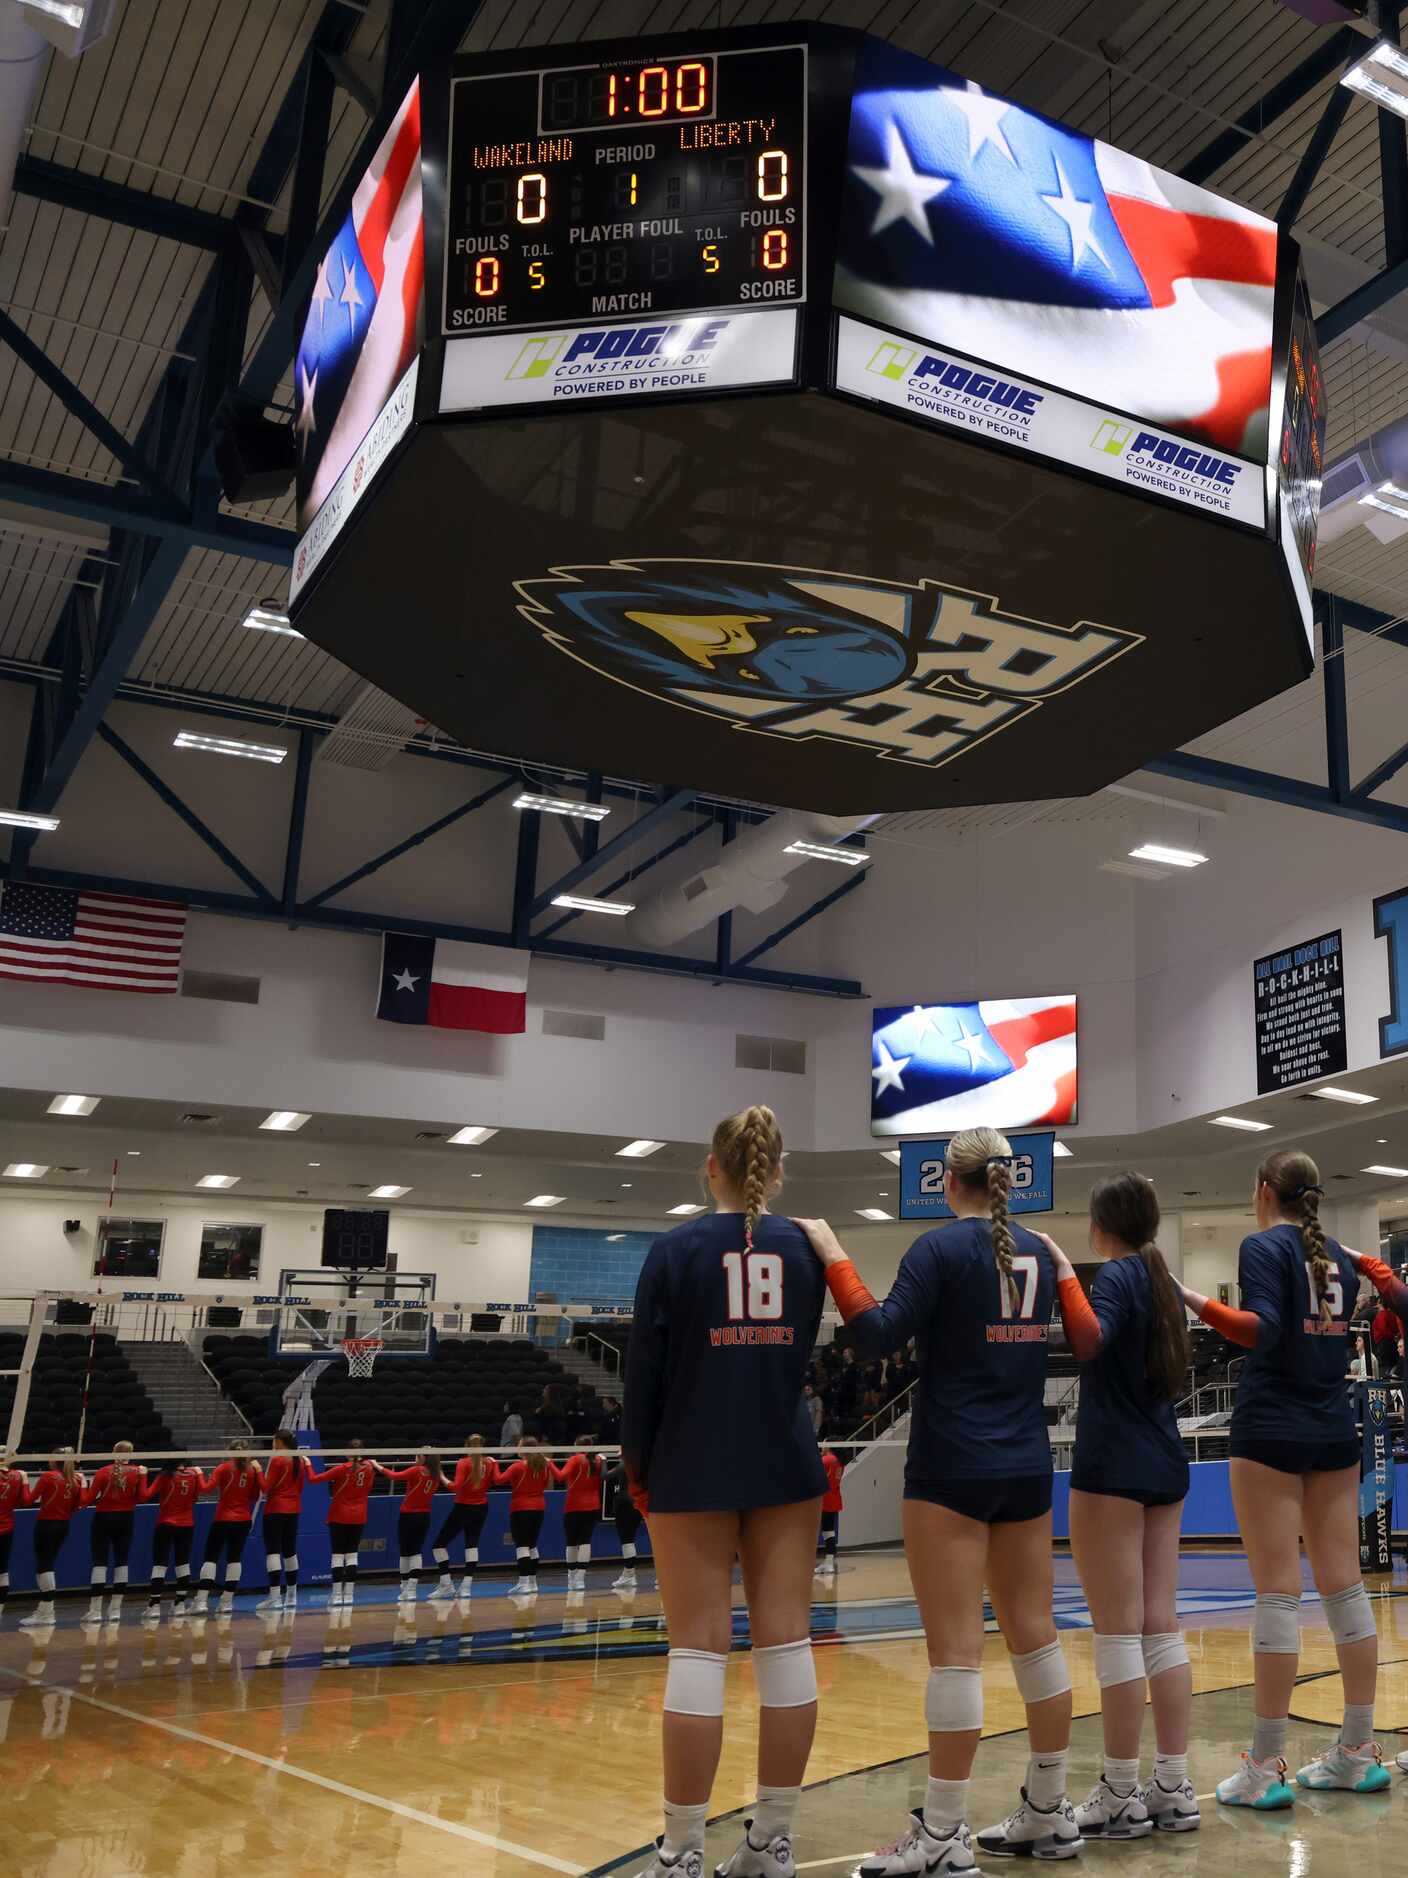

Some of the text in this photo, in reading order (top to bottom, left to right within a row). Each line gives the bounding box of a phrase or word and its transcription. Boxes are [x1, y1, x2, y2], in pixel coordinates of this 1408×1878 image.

[608, 62, 706, 117] 1:00
[679, 118, 776, 150] LIBERTY
[473, 138, 573, 169] WAKELAND
[595, 144, 656, 165] PERIOD
[629, 173, 638, 205] 1
[758, 151, 787, 201] 0
[516, 173, 546, 224] 0
[569, 218, 684, 244] PLAYER FOUL
[740, 208, 796, 228] FOULS
[455, 235, 510, 255] FOULS
[521, 243, 554, 258] T.O.L.
[695, 227, 728, 242] T.O.L.
[762, 230, 787, 269] 0
[702, 245, 720, 273] 5
[475, 256, 498, 296] 0
[527, 262, 545, 289] 5
[739, 279, 796, 300] SCORE
[452, 306, 508, 326] SCORE
[592, 292, 652, 313] MATCH
[562, 320, 731, 363] POGUE
[554, 352, 711, 376] CONSTRUCTION
[553, 371, 706, 396] POWERED BY PEOPLE
[912, 355, 1045, 417] POGUE
[906, 393, 1029, 442] POWERED BY PEOPLE
[907, 378, 1031, 426] CONSTRUCTION
[1125, 453, 1232, 495] CONSTRUCTION
[1130, 431, 1243, 486] POGUE
[1125, 467, 1231, 511] POWERED BY PEOPLE
[722, 1252, 784, 1321] 18
[996, 1255, 1039, 1319] 17
[374, 1299, 428, 1310] ROCK HILL
[1367, 1388, 1387, 1402] RH
[1374, 1433, 1389, 1565] BLUE HAWKS
